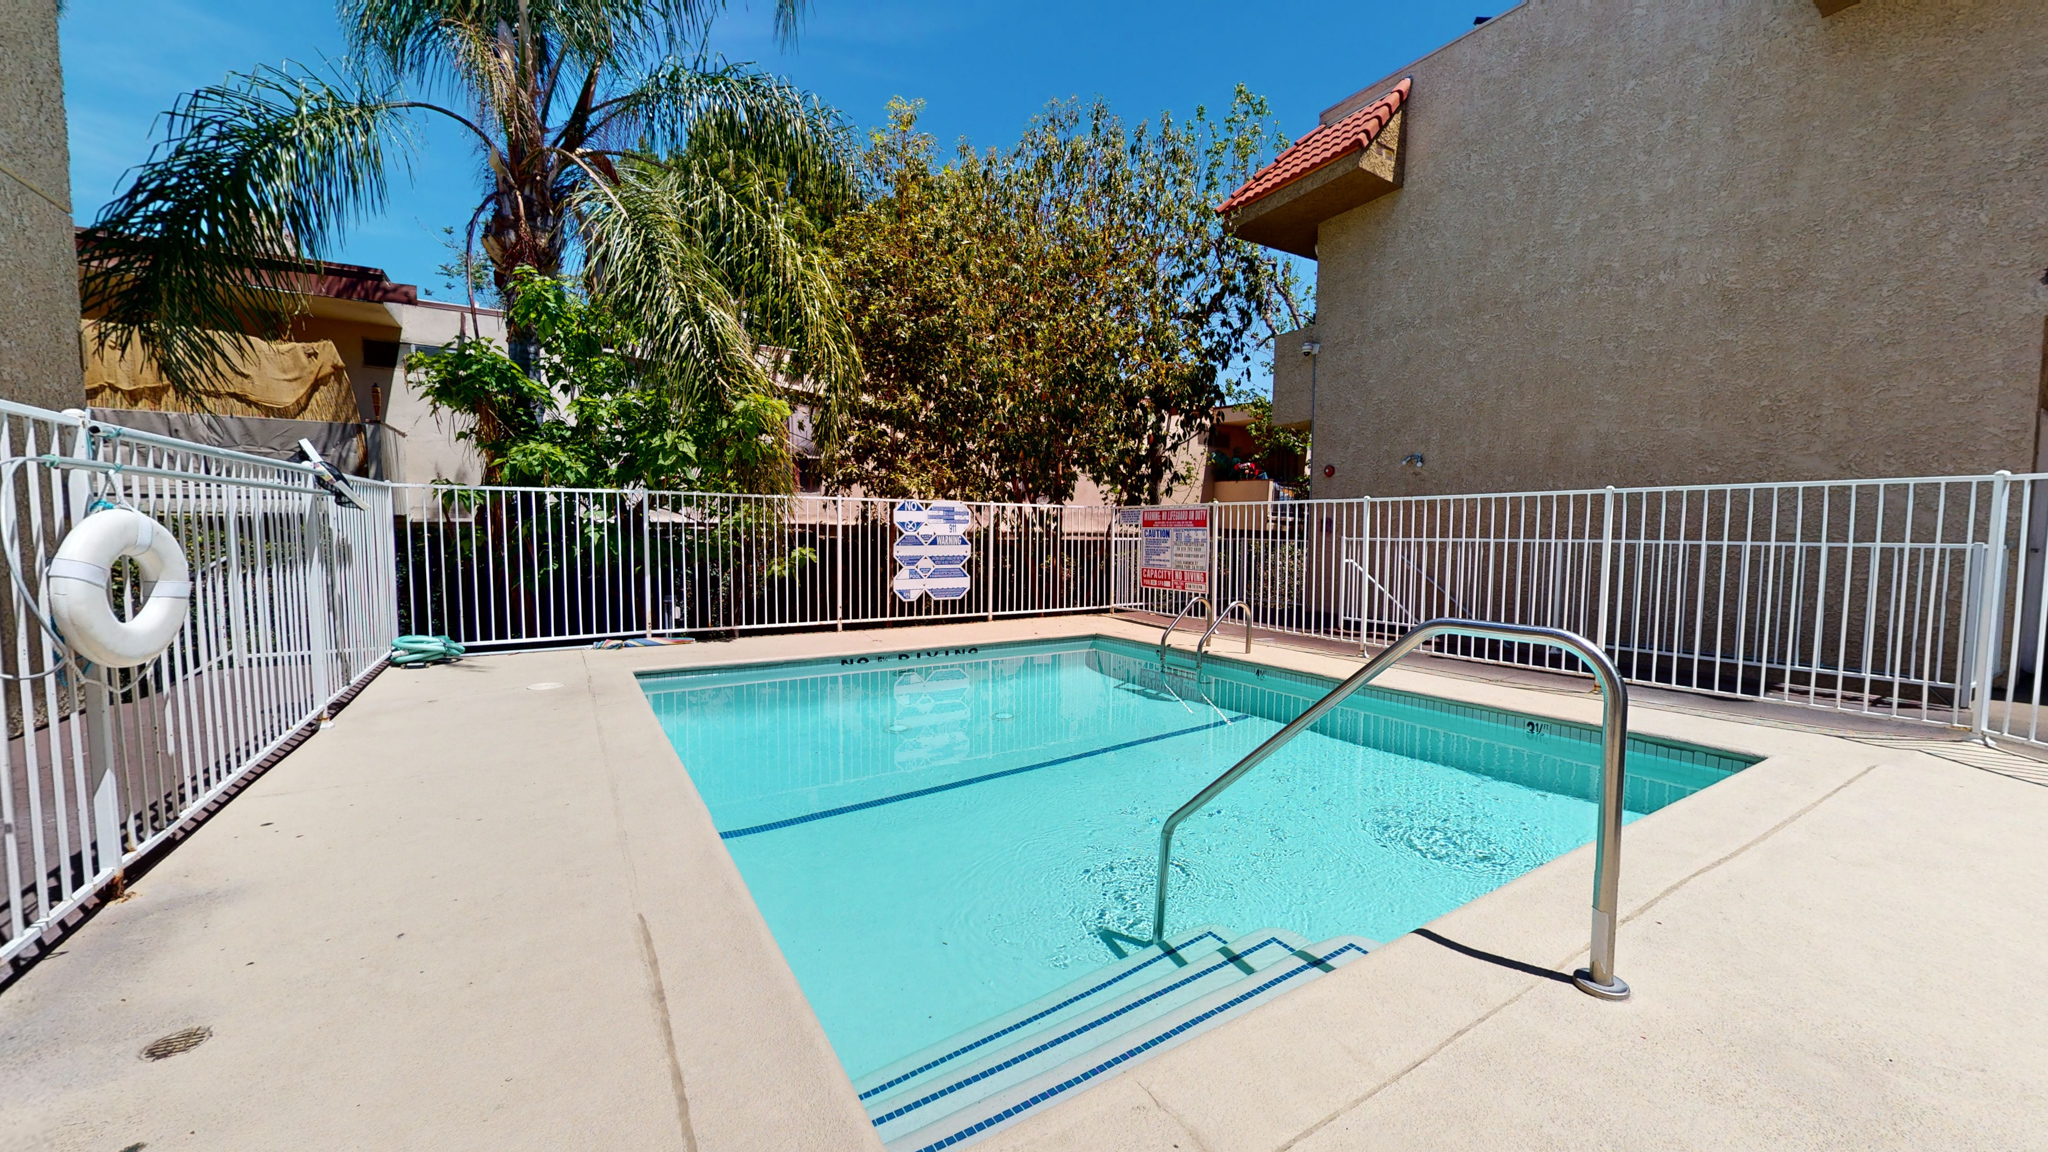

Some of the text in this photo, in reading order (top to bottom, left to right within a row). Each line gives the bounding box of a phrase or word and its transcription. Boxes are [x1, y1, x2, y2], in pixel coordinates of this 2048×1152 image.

[904, 502, 917, 511] NO
[1168, 510, 1188, 520] LIFEGUARD
[1195, 509, 1206, 520] DUTY
[1144, 529, 1170, 538] CAUTION
[936, 535, 962, 545] WARNING
[1143, 569, 1171, 580] CAPACITY
[1175, 571, 1204, 582] NO DIVING
